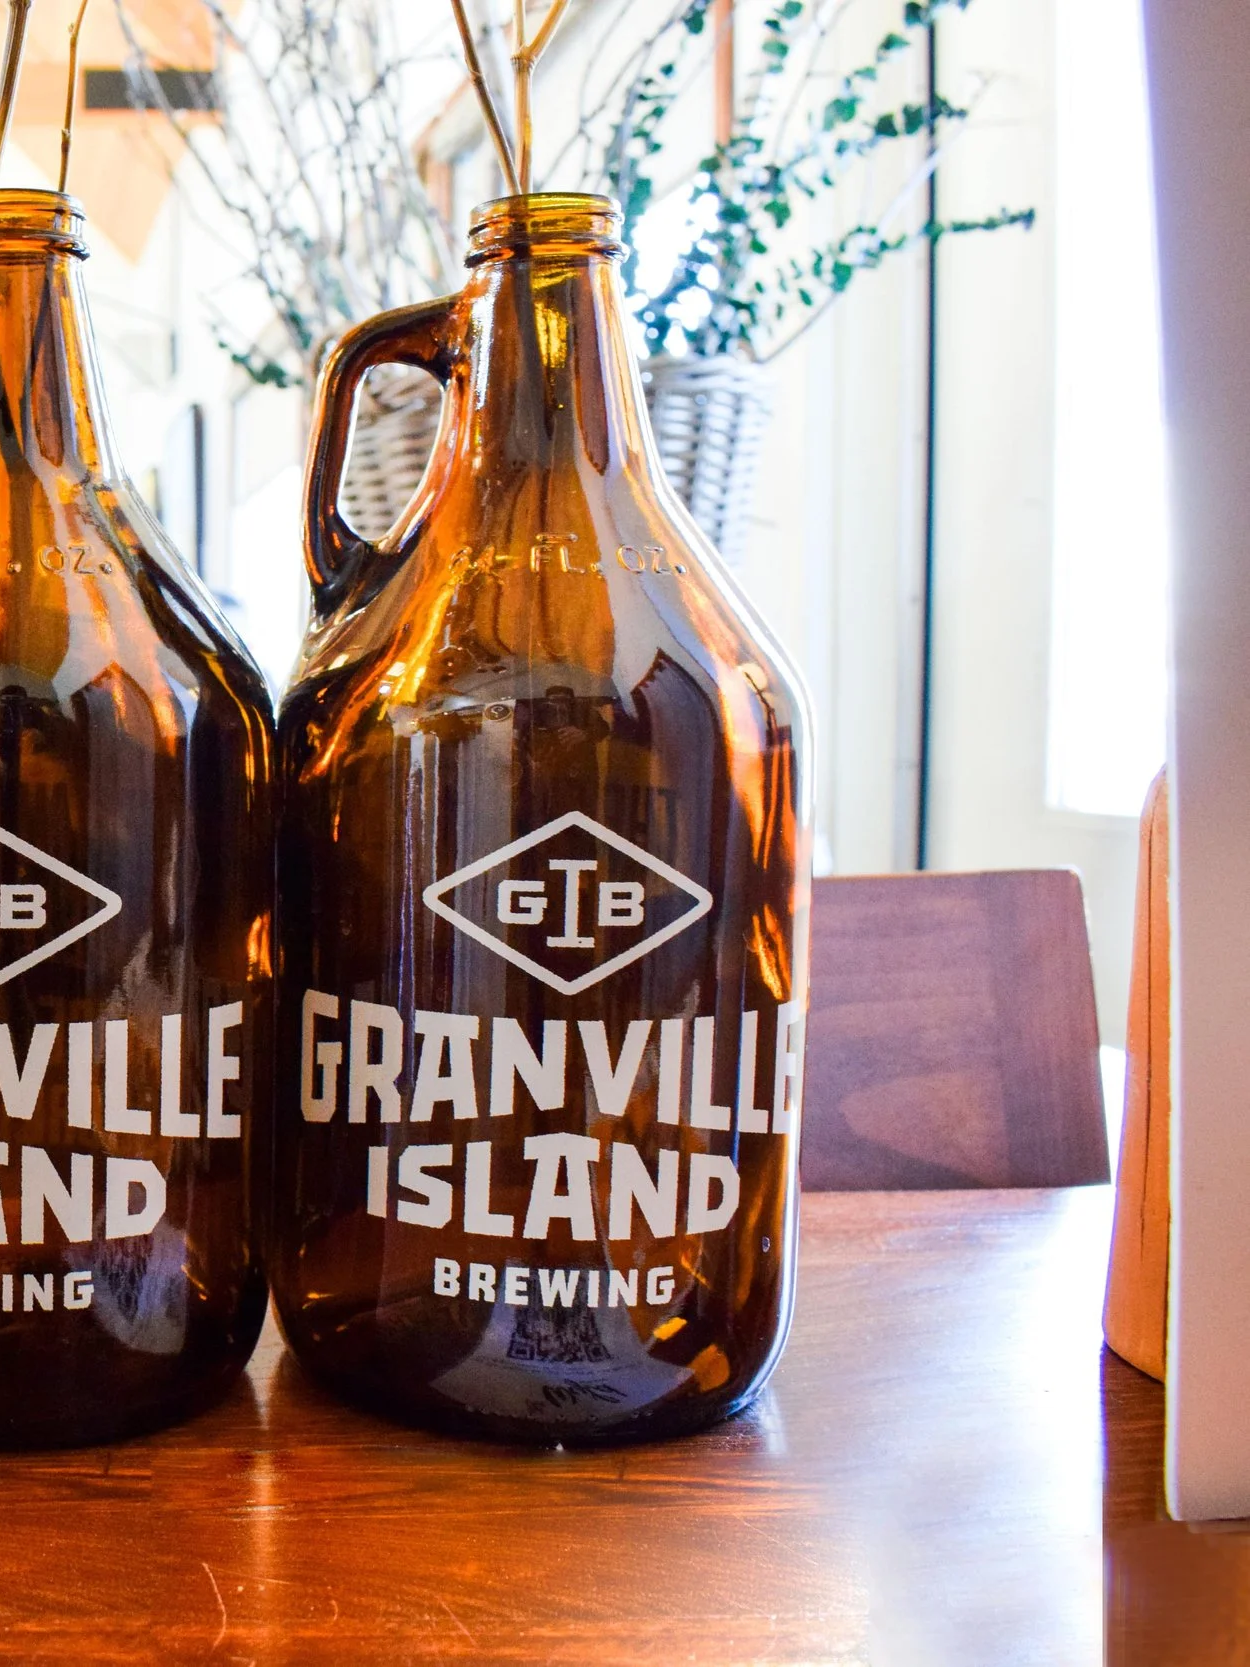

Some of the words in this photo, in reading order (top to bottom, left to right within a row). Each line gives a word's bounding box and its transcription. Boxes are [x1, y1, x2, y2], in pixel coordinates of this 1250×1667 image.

[39, 546, 112, 575] OZ.
[497, 859, 645, 948] GIB
[300, 989, 801, 1135] GRANVILLE
[366, 1131, 741, 1241] ISLAND
[433, 1258, 676, 1308] BREWING
